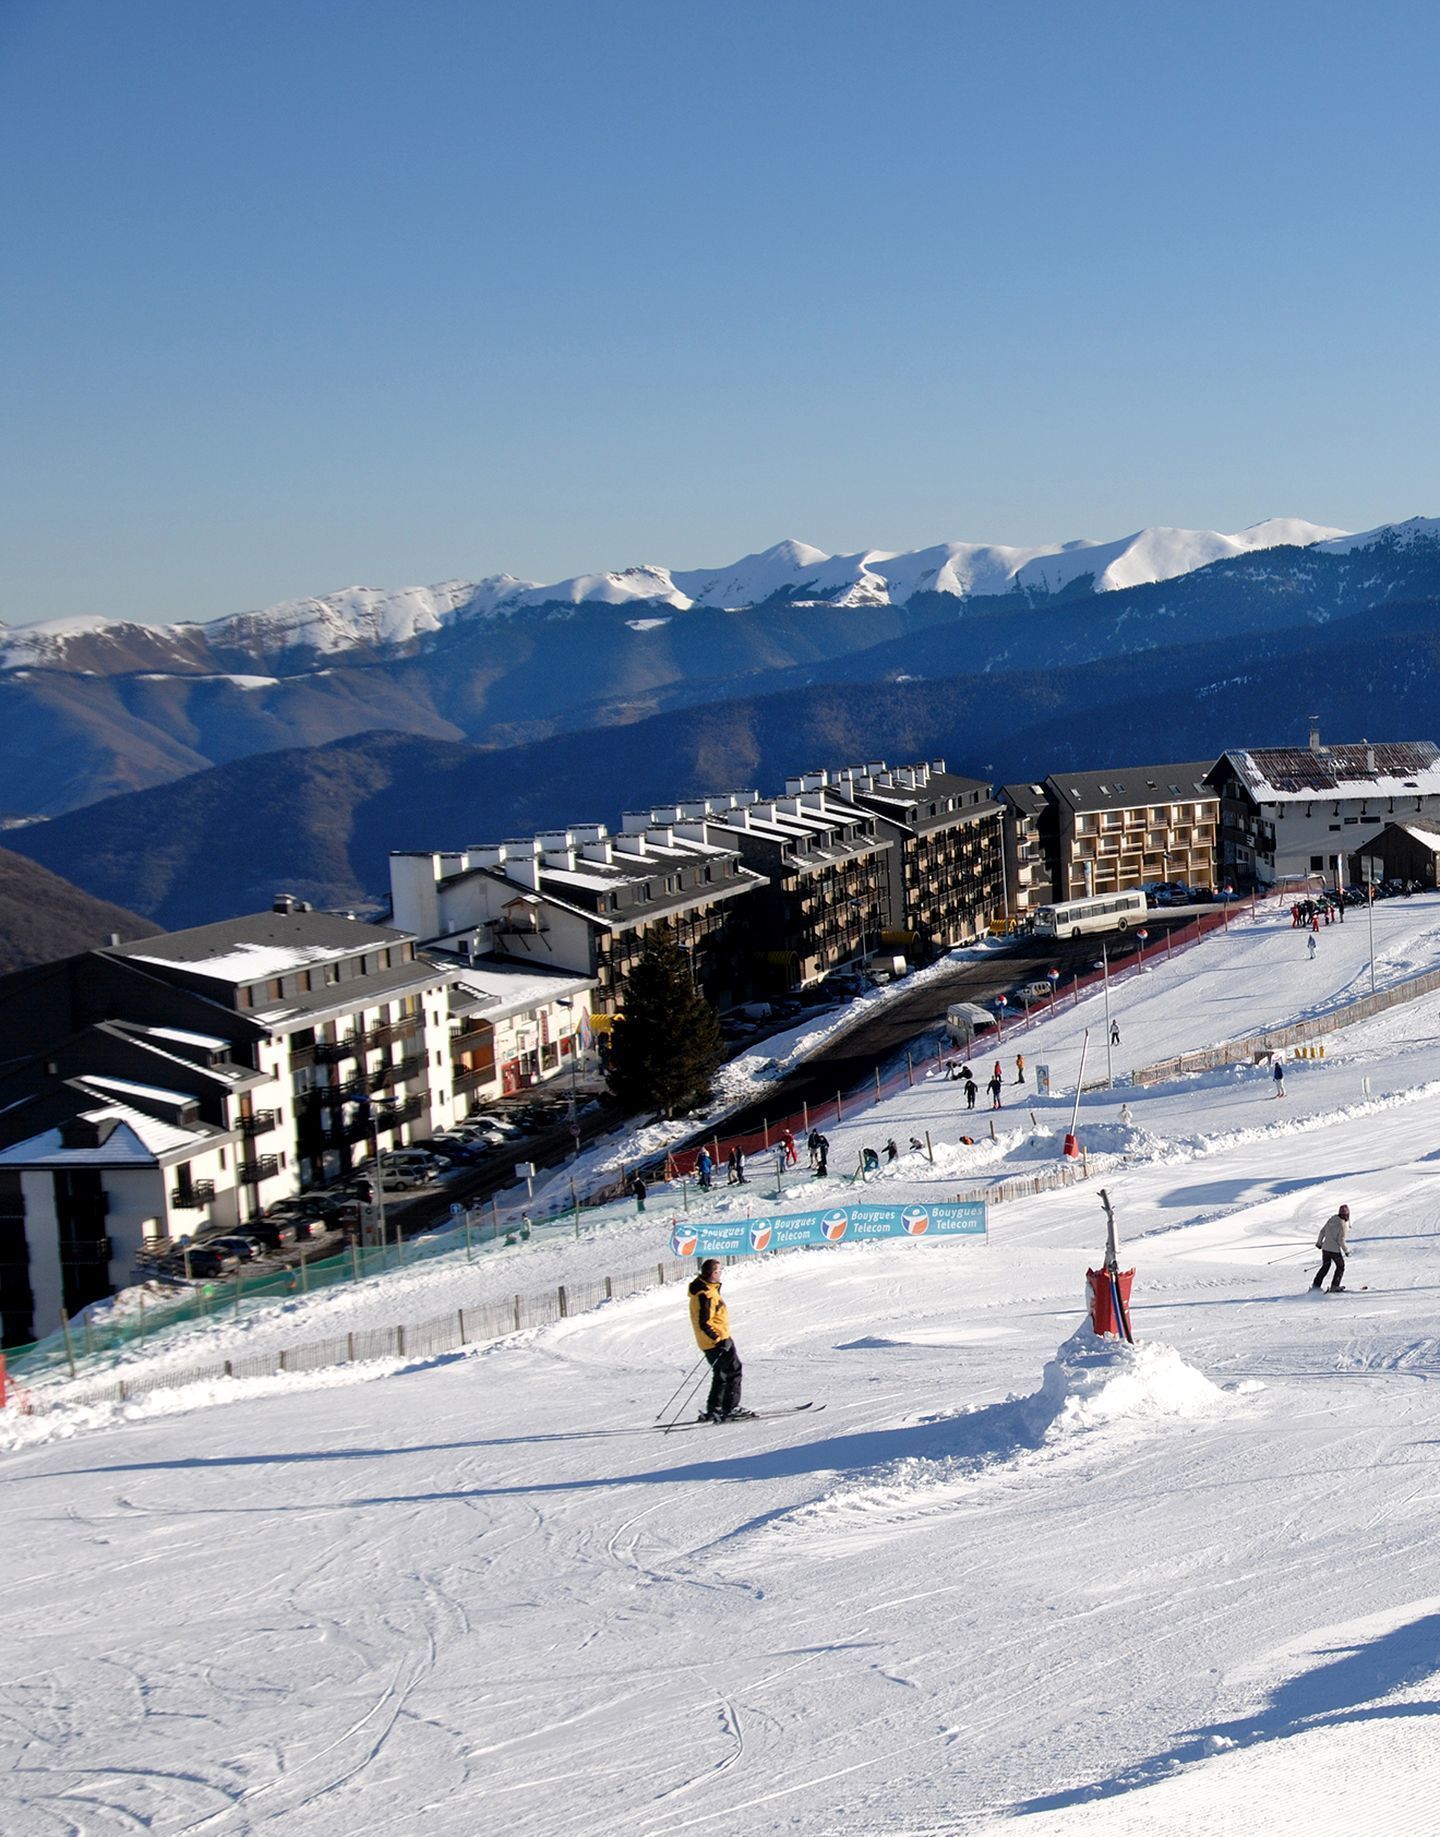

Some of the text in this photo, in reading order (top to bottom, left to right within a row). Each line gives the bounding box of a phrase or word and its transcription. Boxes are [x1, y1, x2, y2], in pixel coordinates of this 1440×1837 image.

[851, 1210, 895, 1221] Bouygues
[932, 1207, 983, 1219] Bouygues
[775, 1217, 816, 1230] Bouygues
[854, 1222, 891, 1233] Telecom
[936, 1218, 977, 1230] Telecom
[777, 1229, 811, 1242] Telecom
[703, 1239, 739, 1251] Telecom
